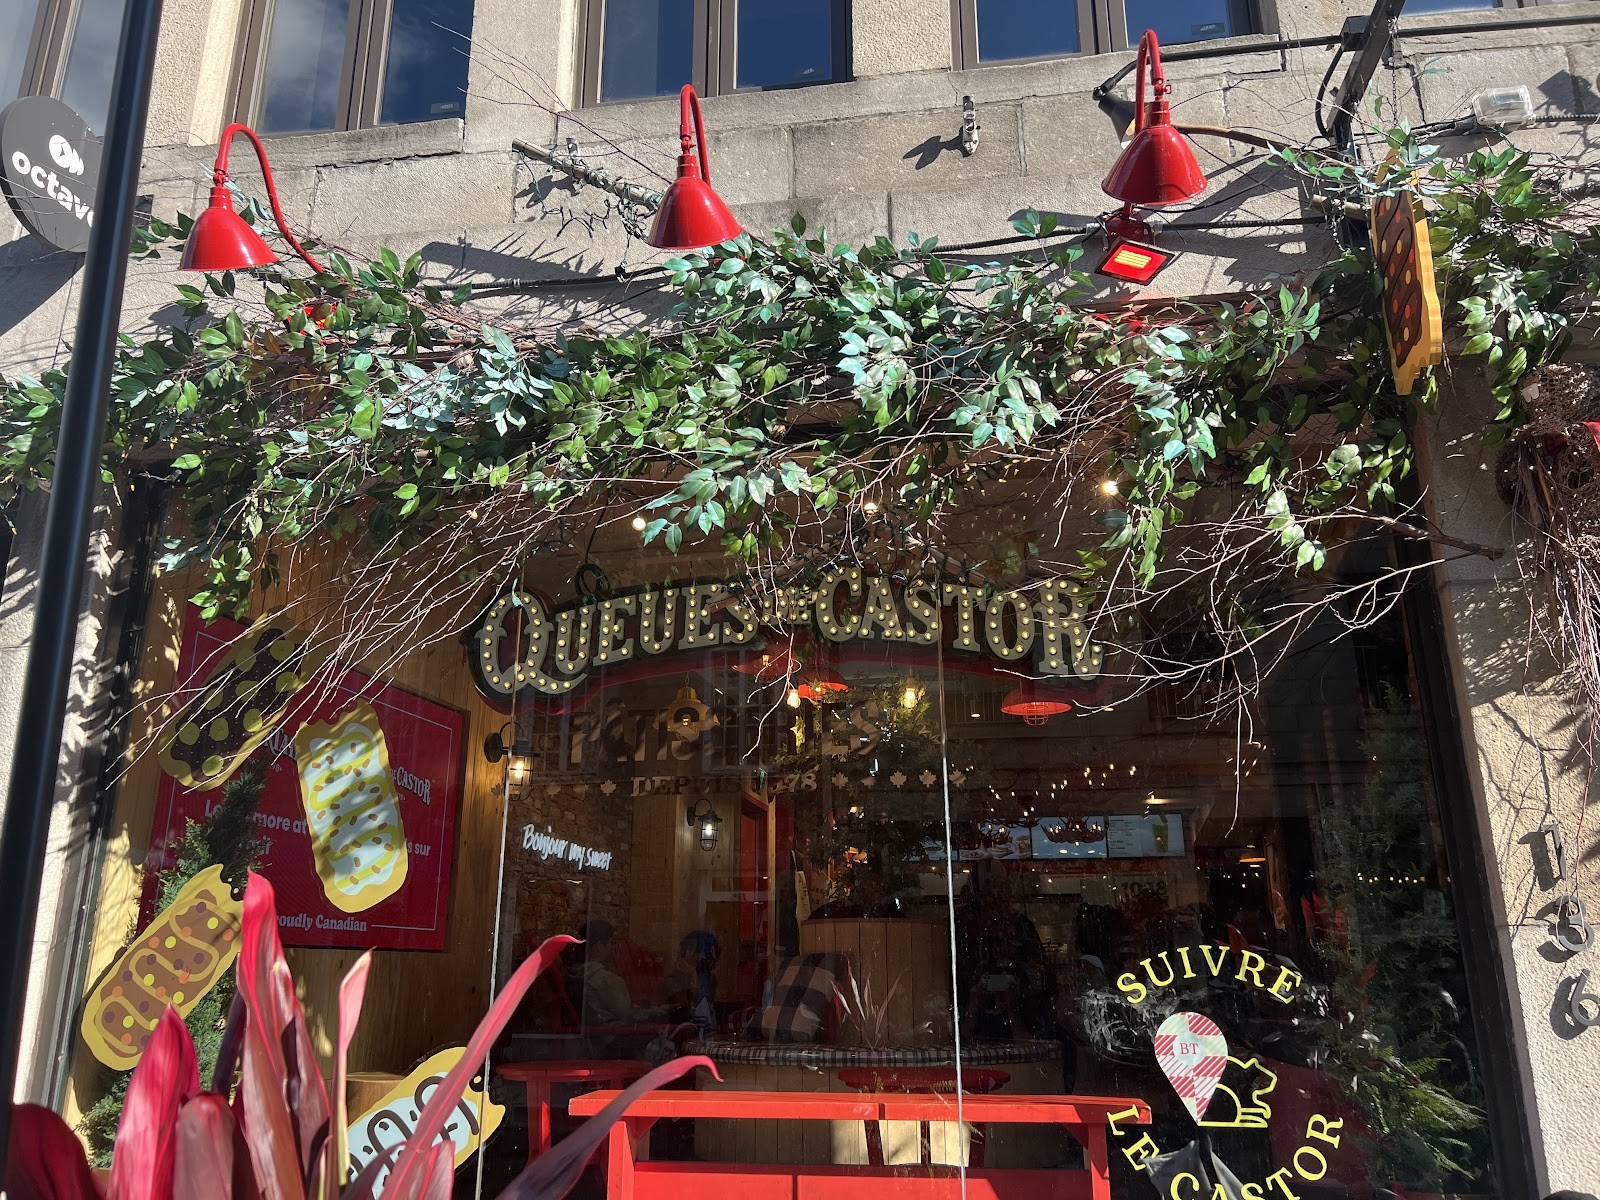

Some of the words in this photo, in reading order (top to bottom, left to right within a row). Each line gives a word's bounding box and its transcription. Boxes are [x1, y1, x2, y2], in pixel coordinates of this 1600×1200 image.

[475, 582, 758, 694] QUEUES
[816, 566, 1103, 680] CASTOR
[397, 766, 431, 805] CASTOR
[253, 811, 291, 831] more
[293, 817, 307, 835] at
[522, 823, 568, 860] Bonjour
[414, 843, 431, 856] sur
[277, 913, 313, 931] oudly
[315, 914, 367, 932] Canadian
[1116, 945, 1302, 1004] SUIVRE
[1180, 1042, 1199, 1055] BT
[1107, 1105, 1160, 1171] LE
[1170, 1113, 1344, 1200] CASTOR
